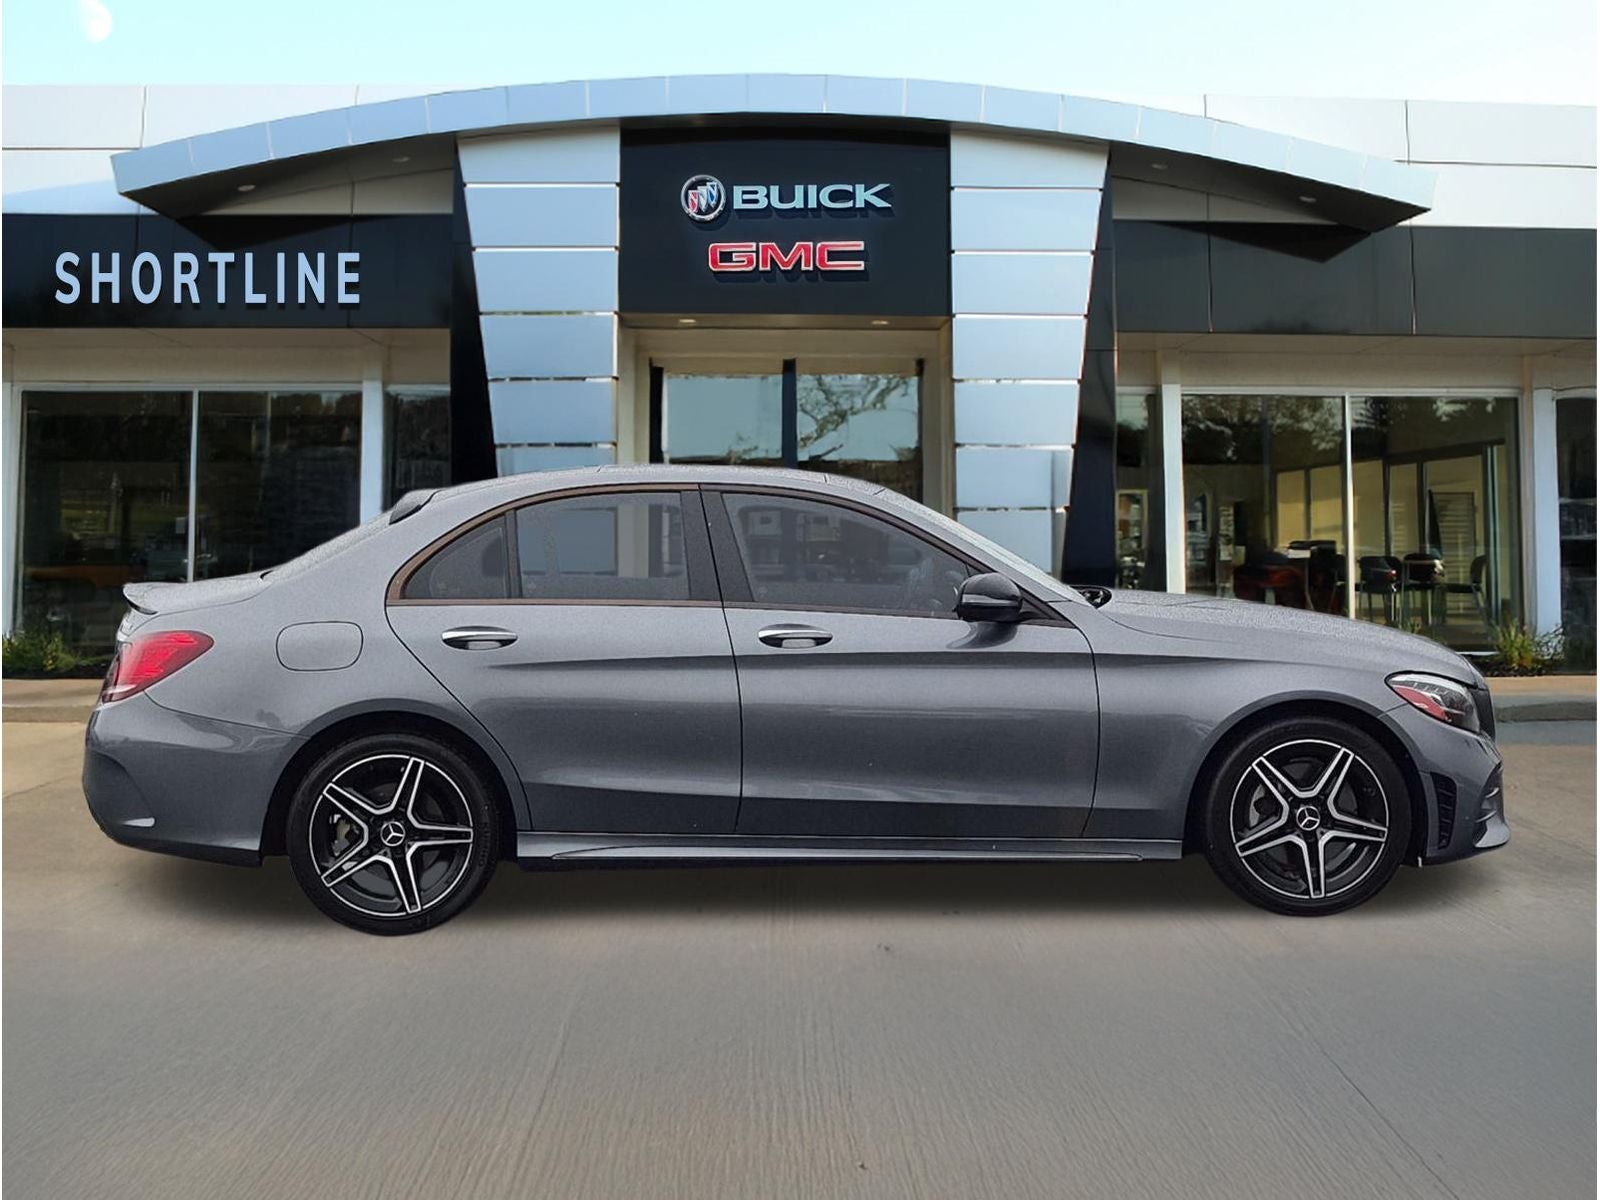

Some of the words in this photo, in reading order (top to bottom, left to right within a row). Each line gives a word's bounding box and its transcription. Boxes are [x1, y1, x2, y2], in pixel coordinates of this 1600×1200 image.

[733, 183, 892, 210] BUICK
[708, 241, 865, 272] GMC
[54, 251, 361, 305] SHORTLINE
